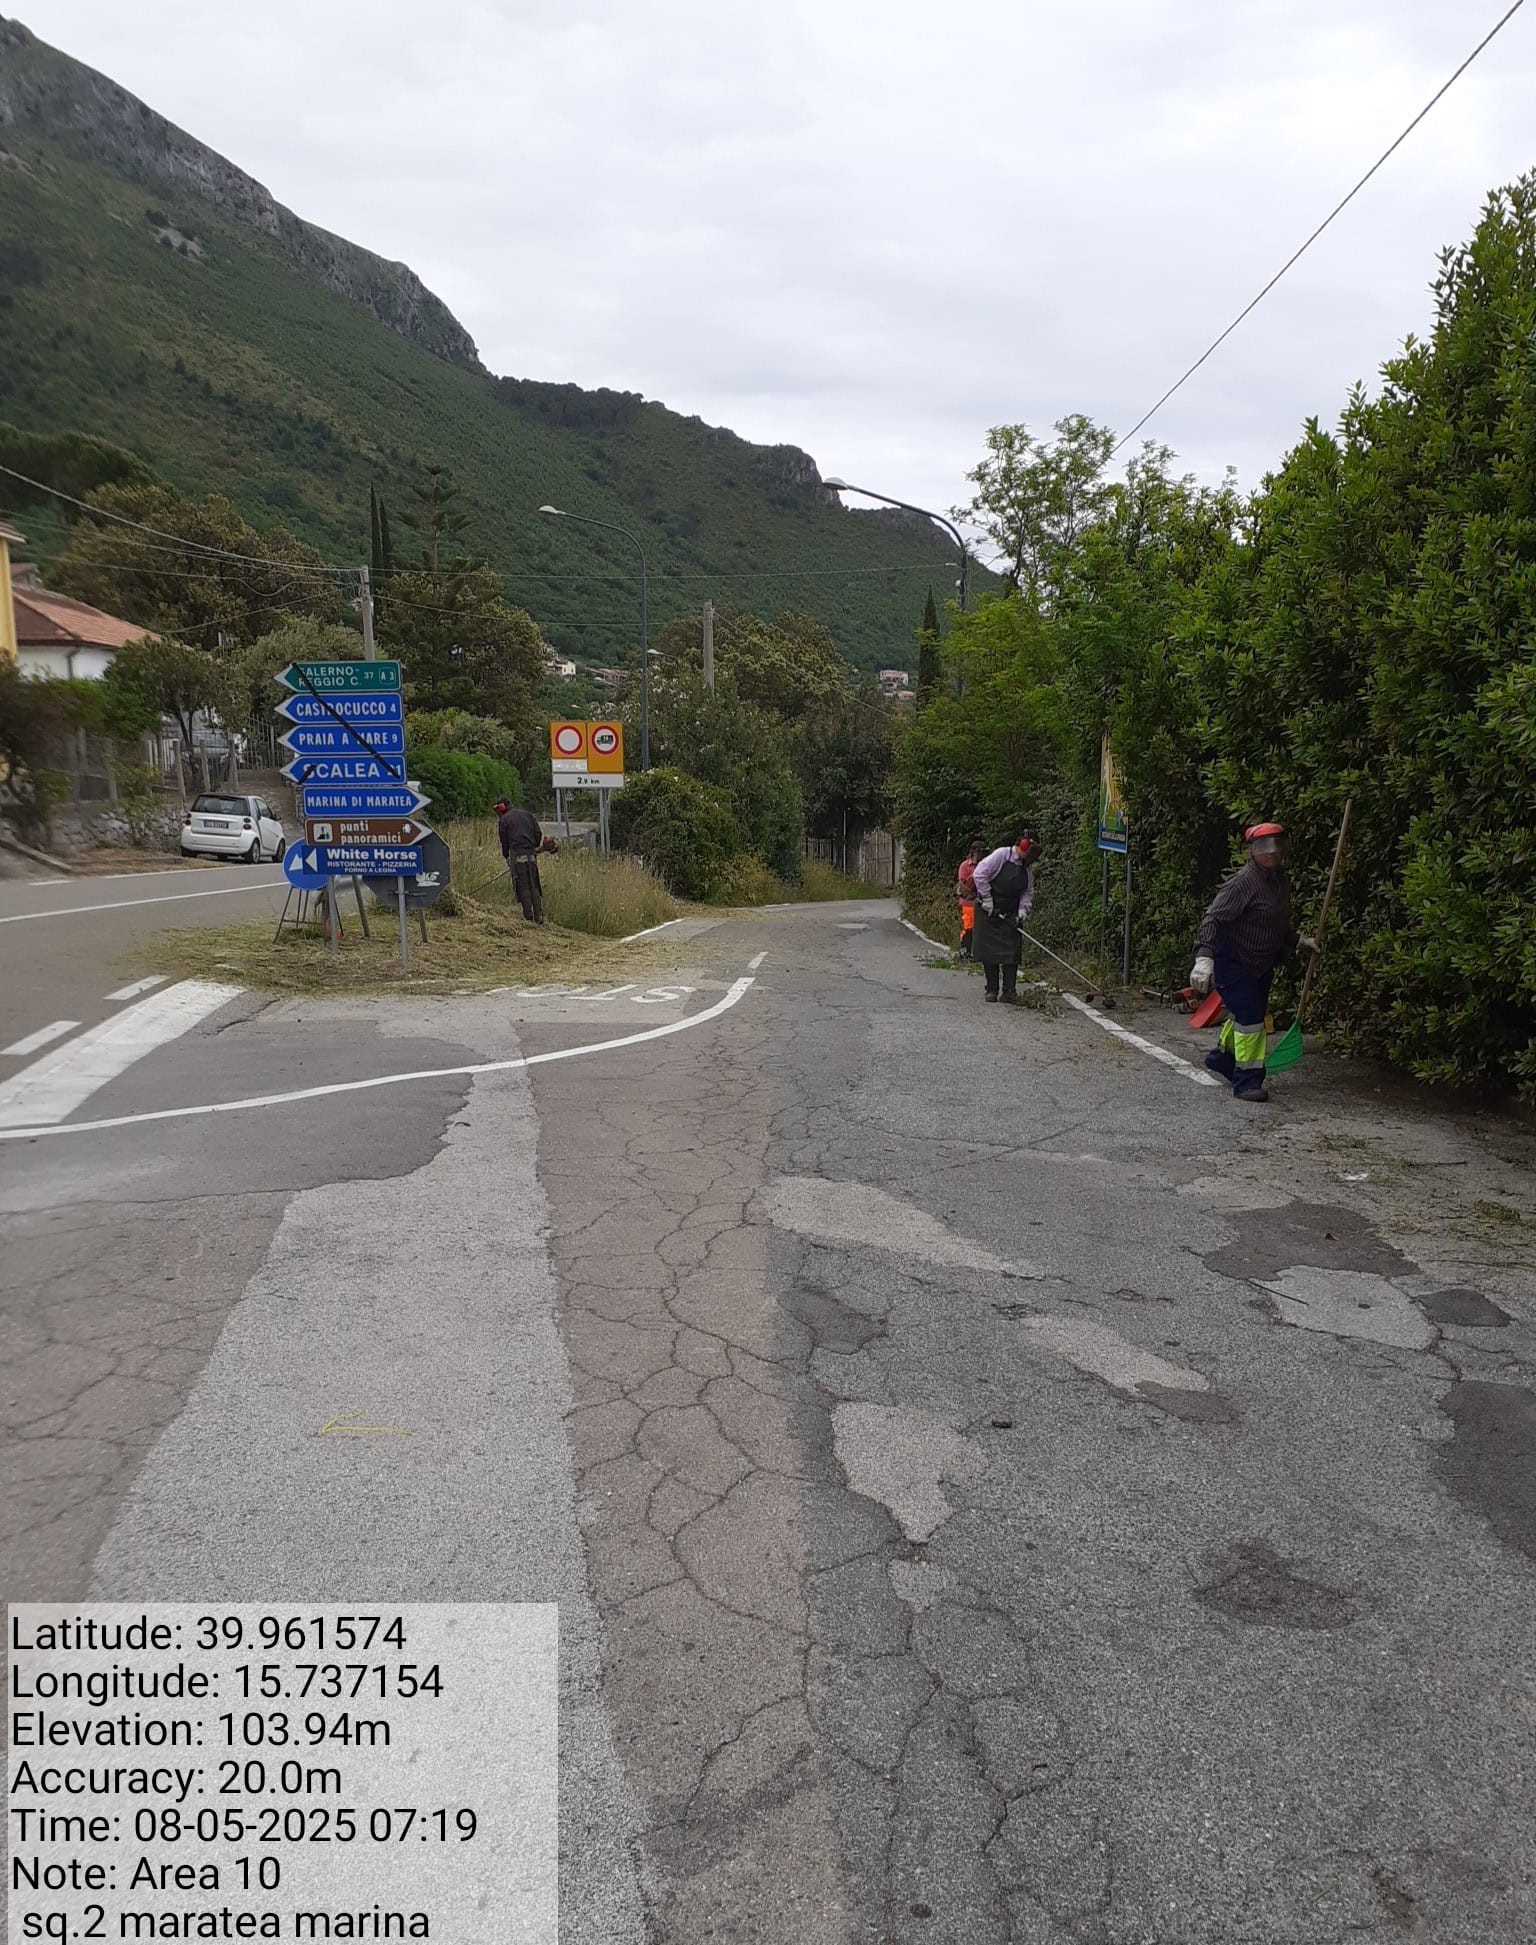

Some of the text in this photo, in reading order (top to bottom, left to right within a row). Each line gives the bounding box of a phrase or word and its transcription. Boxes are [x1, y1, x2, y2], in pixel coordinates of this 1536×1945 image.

[364, 672, 374, 680] 37
[390, 704, 397, 713] 4
[299, 732, 335, 745] PRAIA
[342, 732, 349, 745] A
[391, 734, 398, 743] 9
[303, 763, 380, 778] SCALEA
[307, 795, 412, 807] MARINA DI MARATEA
[340, 820, 369, 833] punti
[340, 831, 401, 845] panoramici
[327, 848, 417, 860] White Horse
